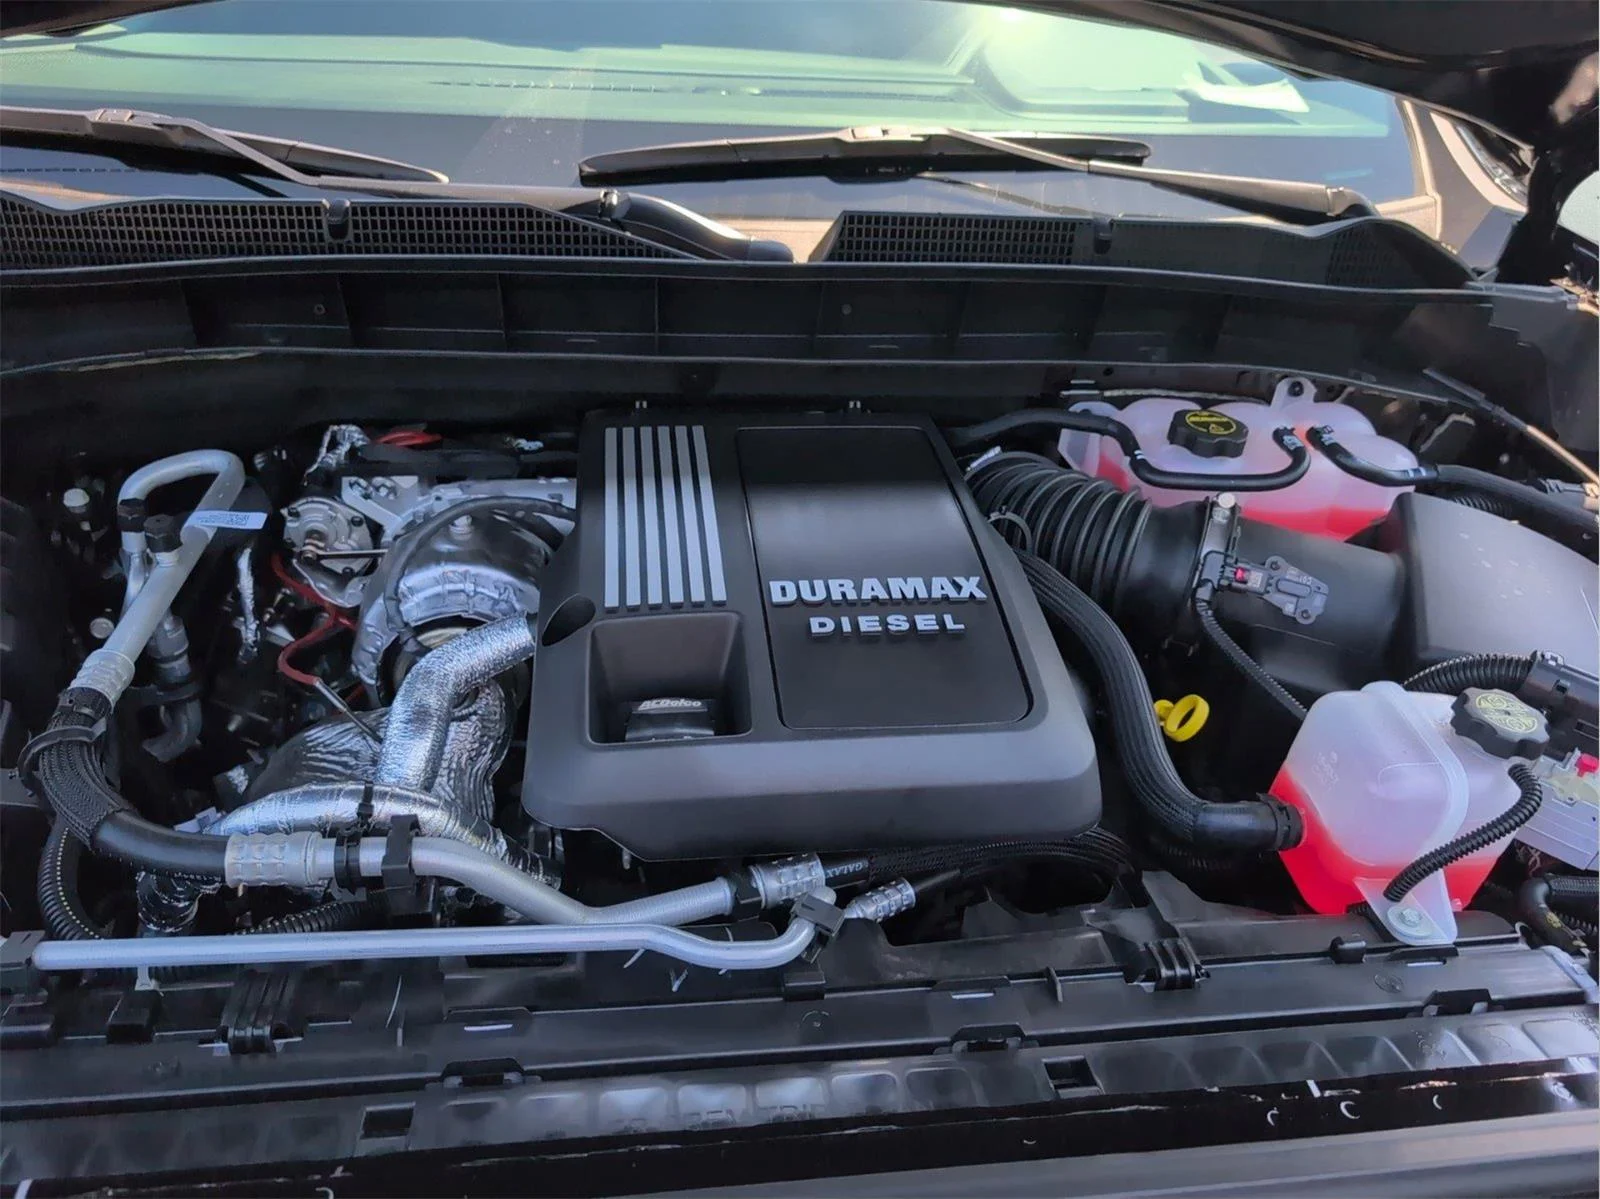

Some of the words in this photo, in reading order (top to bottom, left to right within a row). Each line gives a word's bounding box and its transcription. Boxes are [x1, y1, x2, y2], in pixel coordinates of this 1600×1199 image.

[769, 576, 988, 604] DURAMAX
[809, 614, 966, 635] DIESEL
[638, 699, 702, 711] ACDelco
